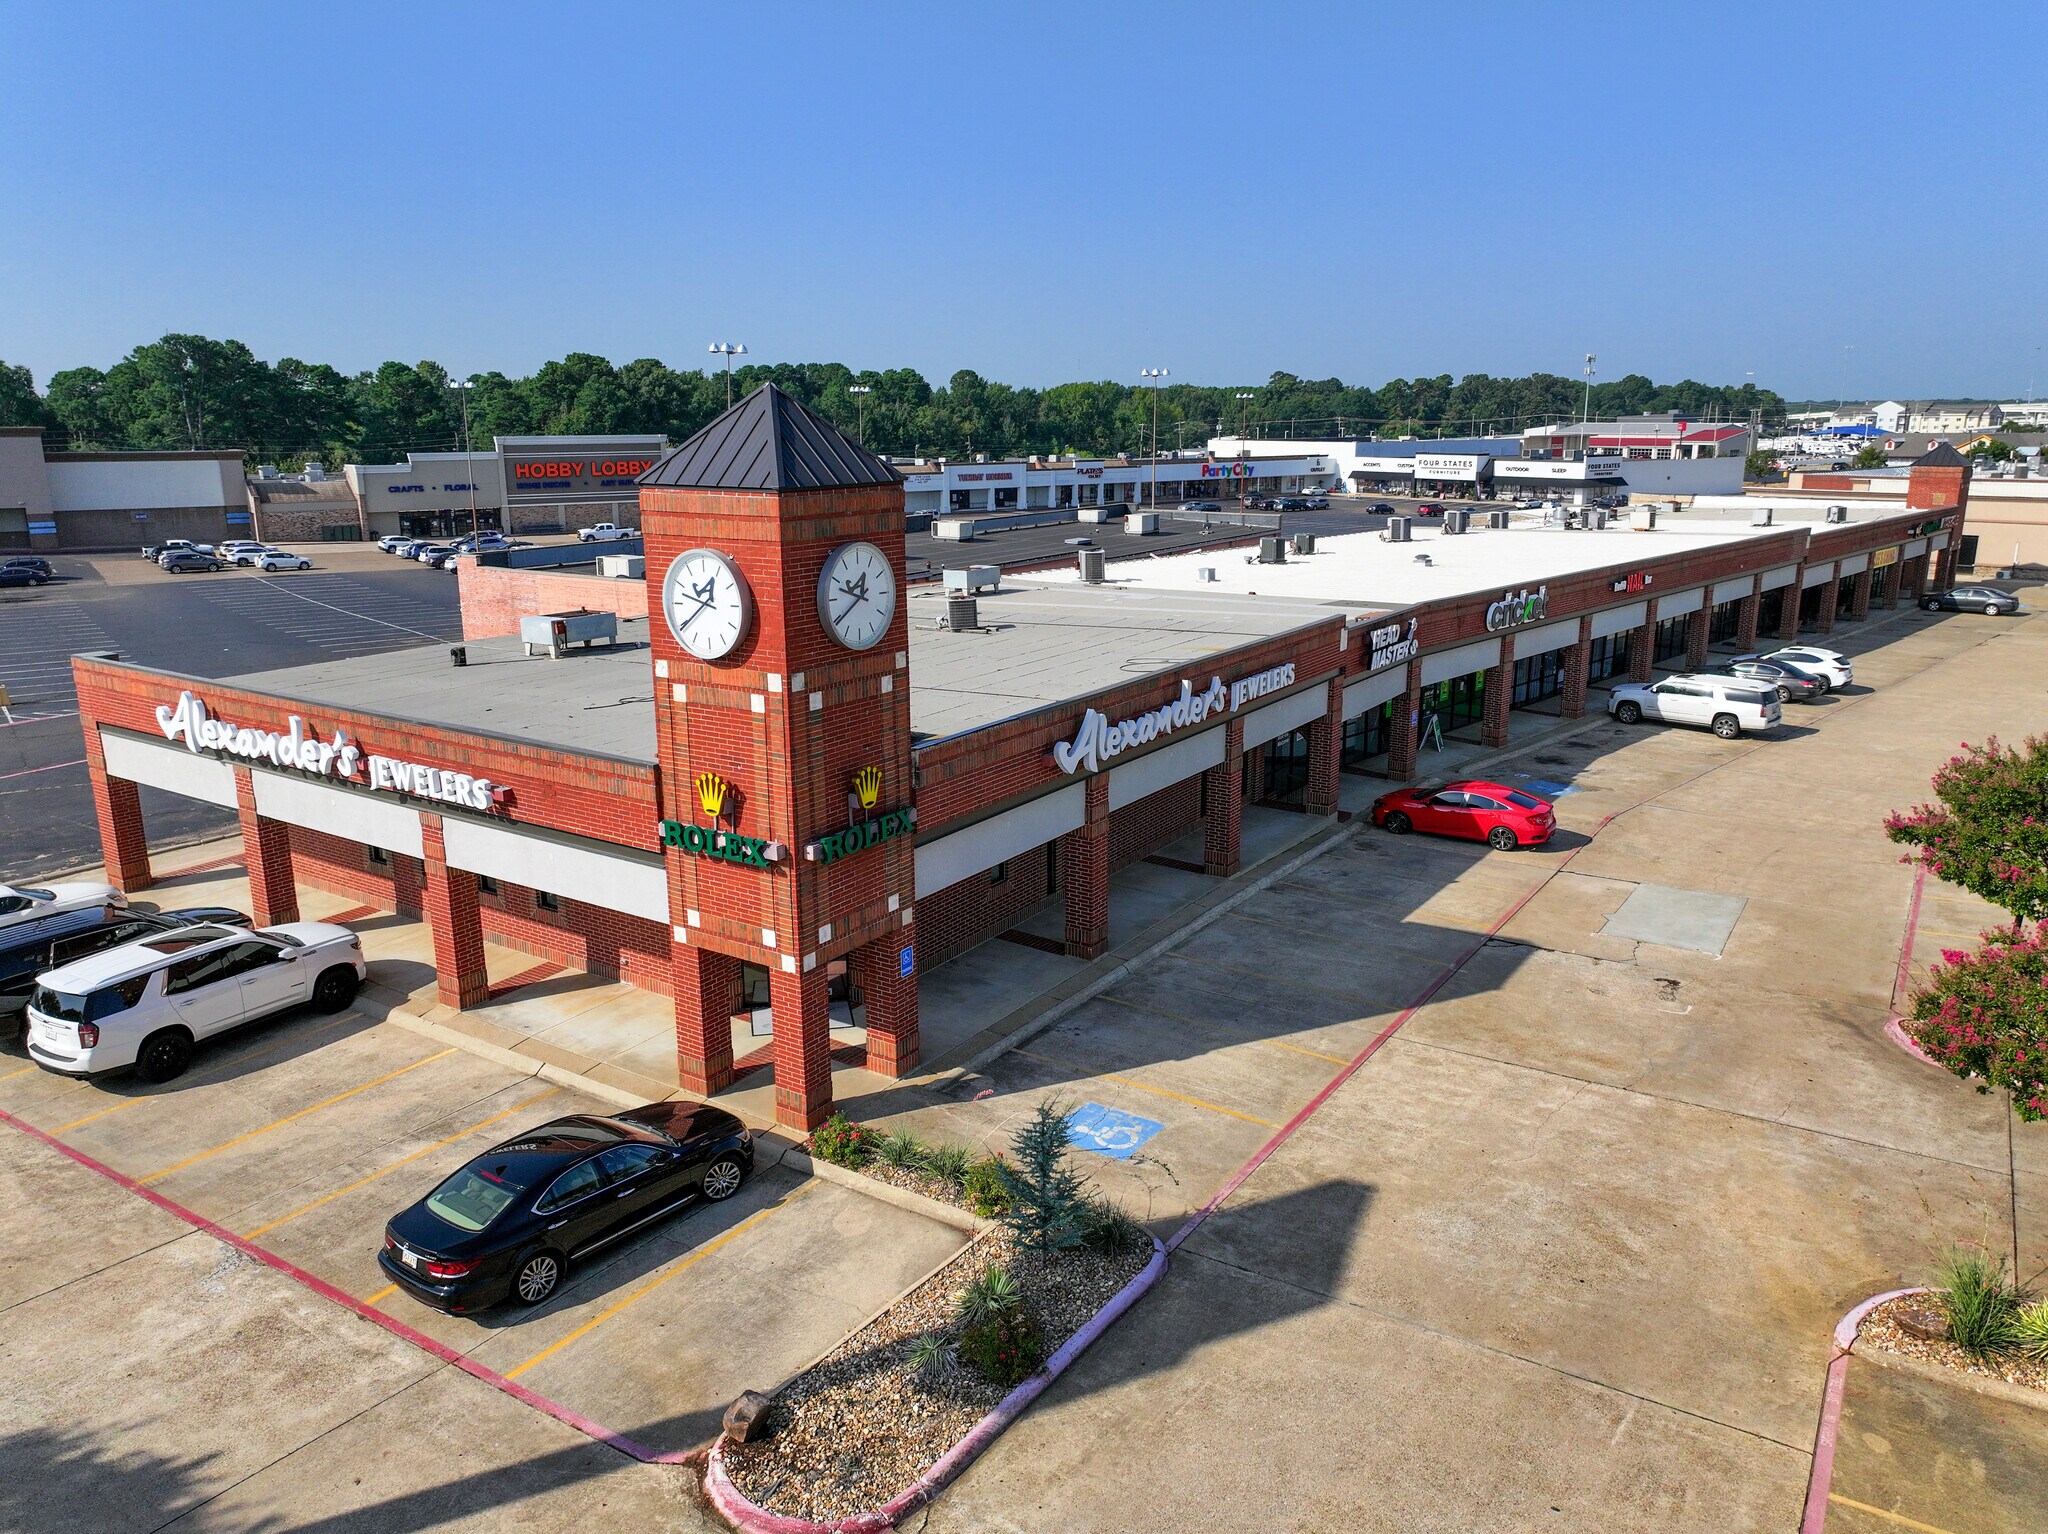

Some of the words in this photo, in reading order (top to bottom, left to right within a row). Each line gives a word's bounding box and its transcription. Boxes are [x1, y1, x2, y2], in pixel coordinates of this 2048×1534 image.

[515, 462, 584, 478] HOBBY
[591, 460, 652, 477] LOBBY
[1418, 459, 1440, 467] FOUR
[1443, 460, 1473, 468] STATES
[388, 485, 424, 493] CRAFTS
[1370, 624, 1401, 651] HEAD
[1054, 676, 1227, 775] Alexander's
[1230, 663, 1296, 713] JEWELERS
[155, 690, 359, 778] Alexander's
[368, 755, 494, 811] JEWELERS
[661, 819, 770, 868] ROLEX
[820, 806, 917, 865] ROLEX
